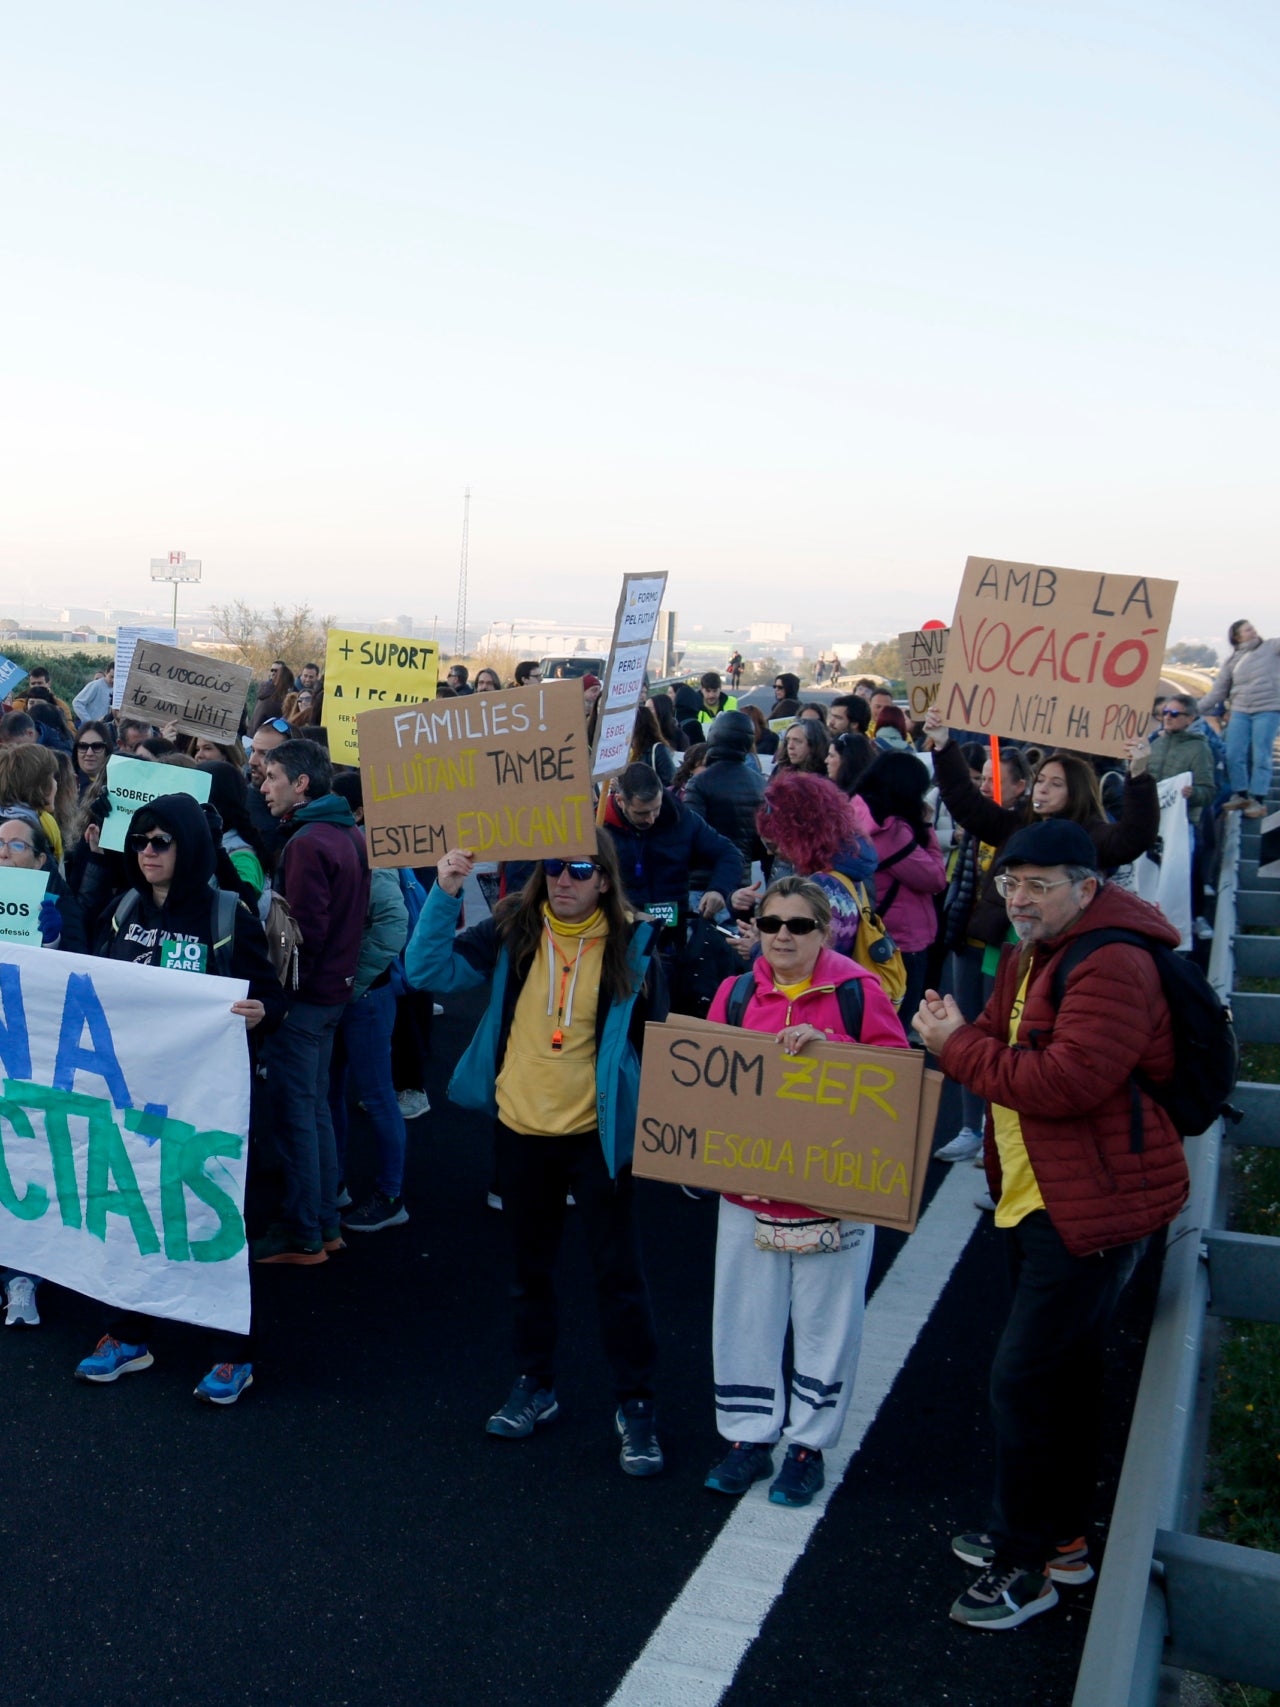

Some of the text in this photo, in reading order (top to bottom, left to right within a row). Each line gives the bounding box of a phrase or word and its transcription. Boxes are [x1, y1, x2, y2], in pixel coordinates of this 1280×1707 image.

[975, 564, 1153, 619] AMB LA
[624, 614, 637, 625] PEL
[137, 650, 160, 676] La
[167, 663, 236, 693] vocació
[360, 640, 434, 670] SUPORT
[132, 686, 233, 727] té un LÍMIT
[612, 681, 639, 696] MEU SOU
[338, 714, 350, 722] FER
[946, 682, 996, 728] NO
[1067, 705, 1090, 739] HA
[1100, 704, 1150, 741] PROU
[486, 733, 577, 786] TAMBÉ
[370, 796, 589, 858] ESTEM EDUCANT
[166, 959, 200, 972] FARÉ
[167, 942, 201, 960] JO
[669, 1039, 899, 1121] SOM ZER
[641, 1117, 697, 1159] SOM
[703, 1129, 795, 1177] ESCOLA
